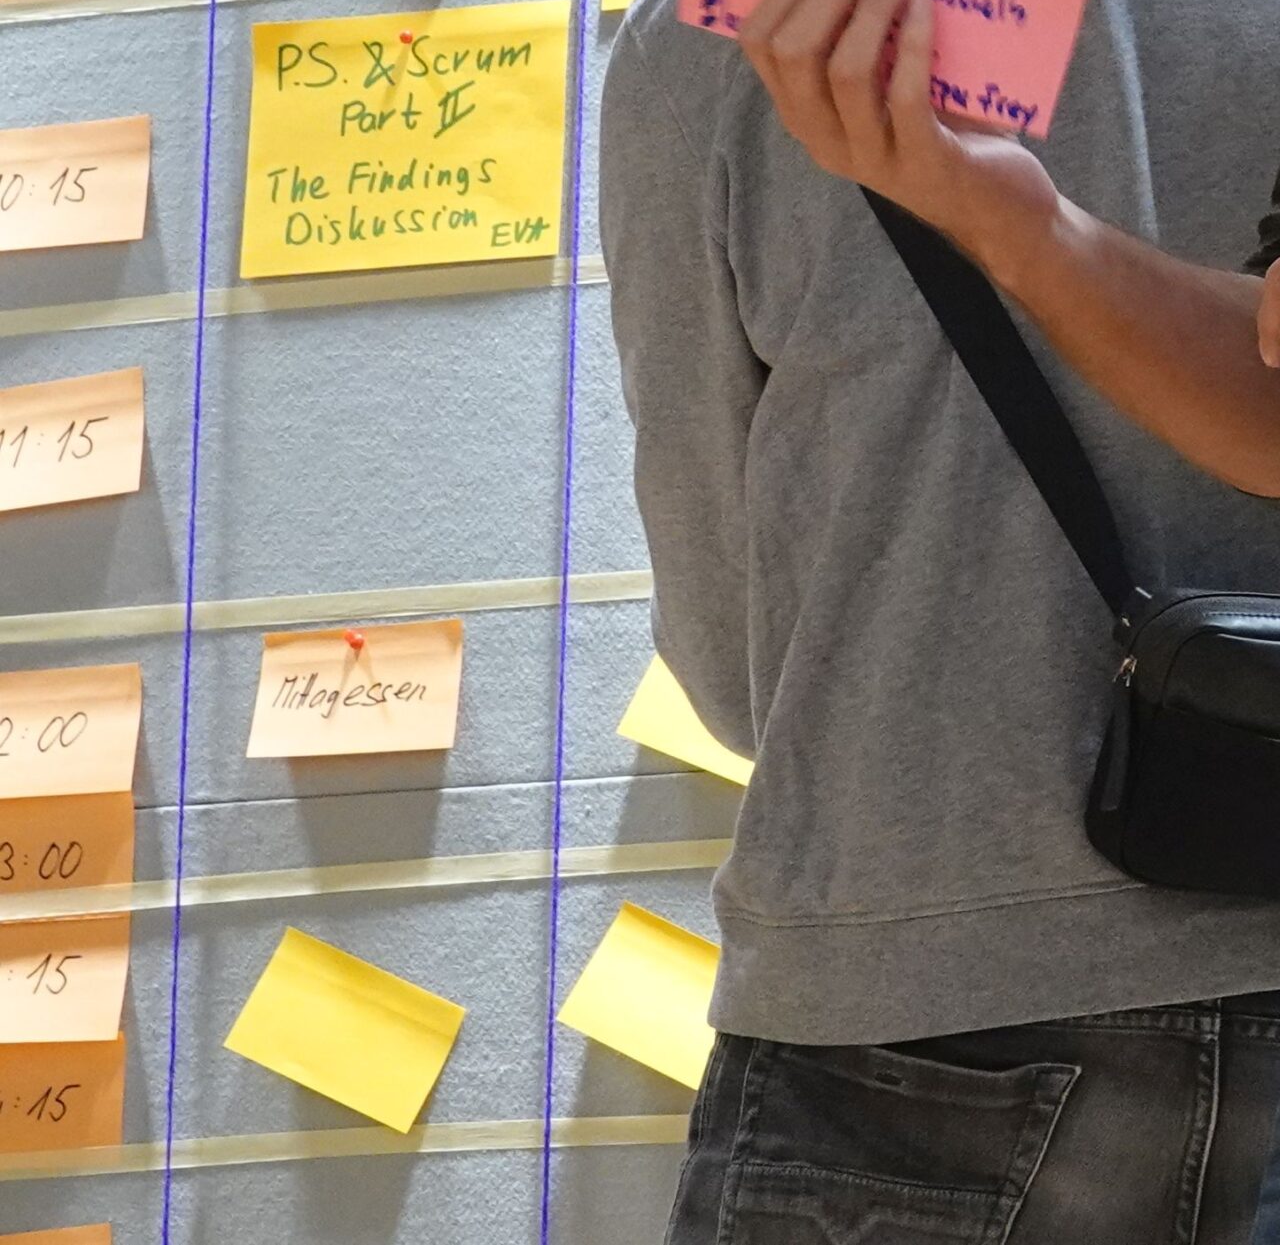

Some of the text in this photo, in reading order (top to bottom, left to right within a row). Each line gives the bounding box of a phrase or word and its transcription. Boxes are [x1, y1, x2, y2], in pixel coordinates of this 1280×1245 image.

[362, 40, 397, 89] &
[406, 34, 533, 78] Scrum
[340, 92, 423, 137] Part
[266, 157, 498, 205] The Findings
[284, 205, 479, 246] Diskussion
[271, 671, 427, 719] Mittagessen
[0, 1083, 82, 1123] :15
